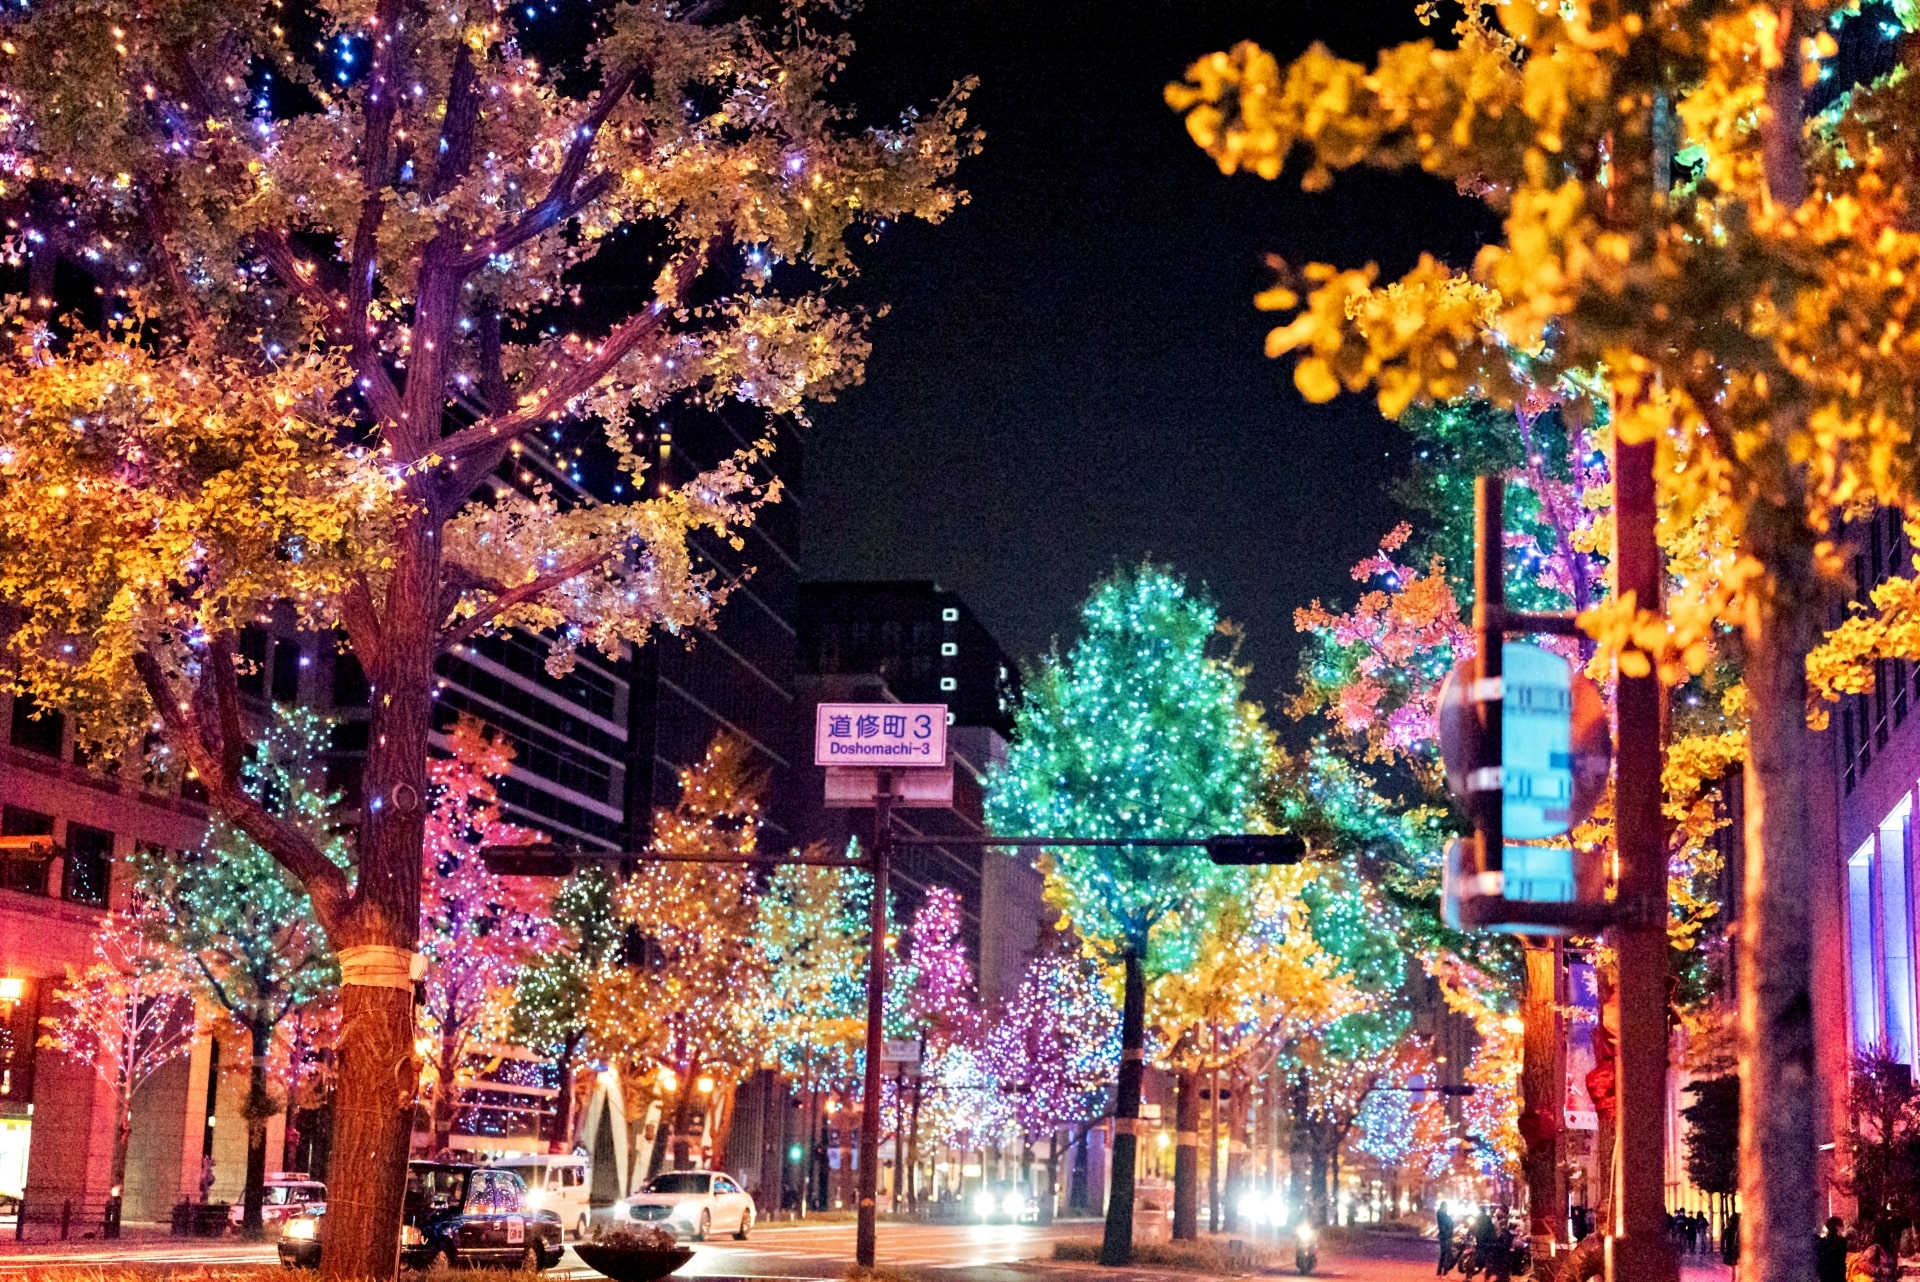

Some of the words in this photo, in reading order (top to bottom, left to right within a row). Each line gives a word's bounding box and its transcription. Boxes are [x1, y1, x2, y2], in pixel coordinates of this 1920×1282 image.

[828, 714, 932, 739] 道修町3
[830, 742, 930, 755] Doshomachi-3
